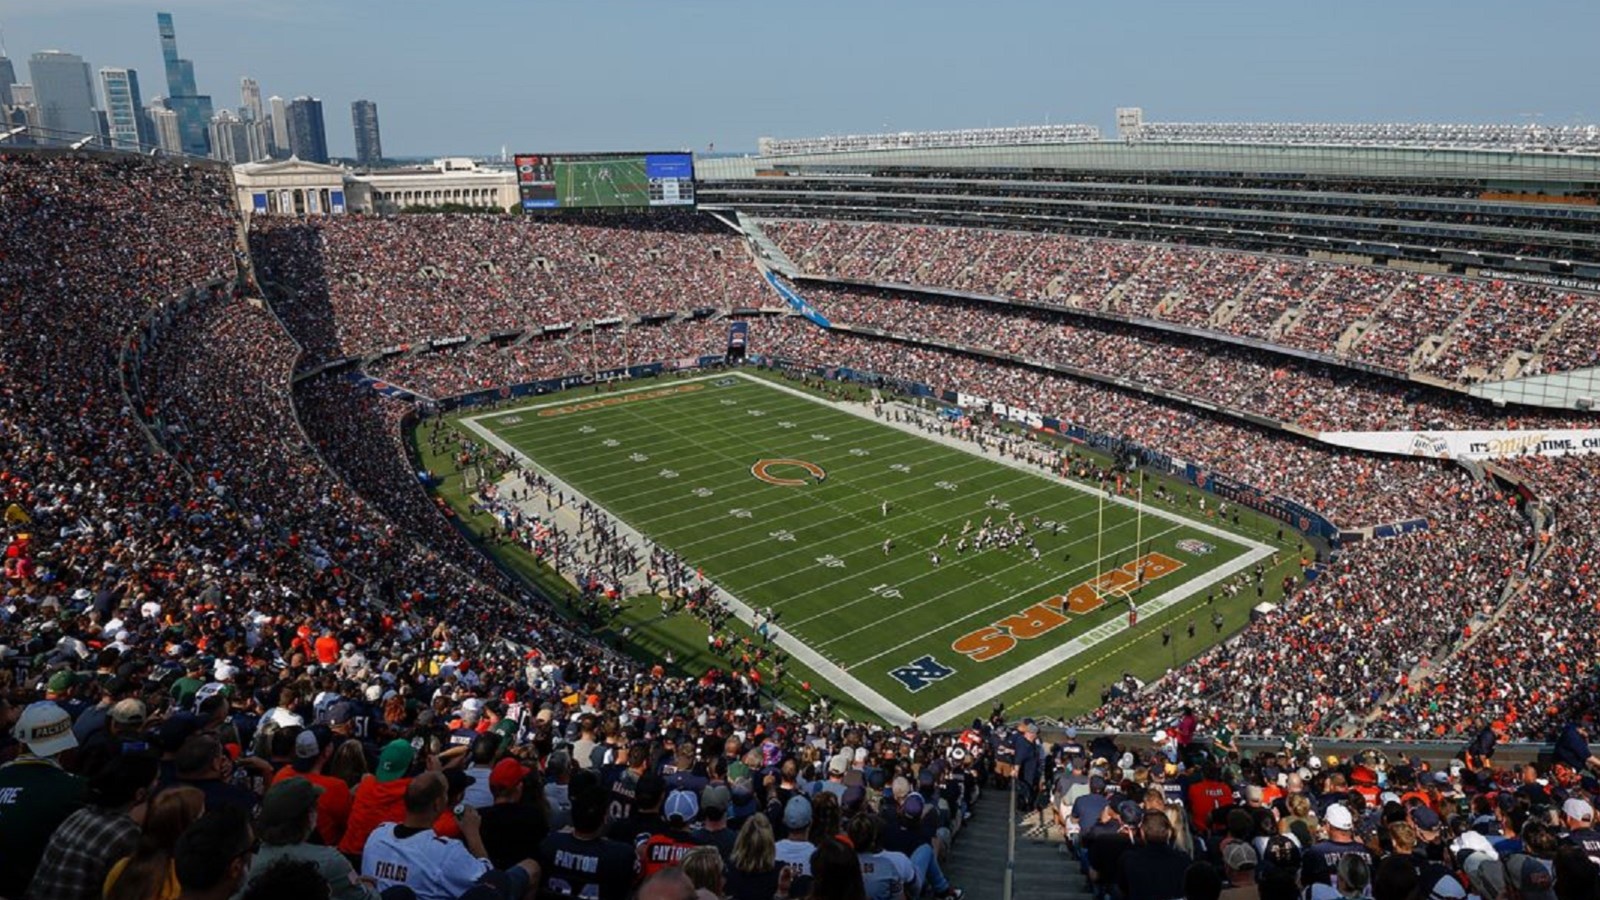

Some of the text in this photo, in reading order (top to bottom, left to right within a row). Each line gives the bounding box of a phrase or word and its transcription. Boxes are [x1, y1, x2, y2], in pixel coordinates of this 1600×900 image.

[1469, 442, 1491, 453] IT'S
[1540, 438, 1577, 450] TIME,
[951, 551, 1187, 663] BEARS
[355, 716, 369, 737] 51
[375, 860, 407, 882] FIELDS
[554, 850, 599, 873] PAYTON
